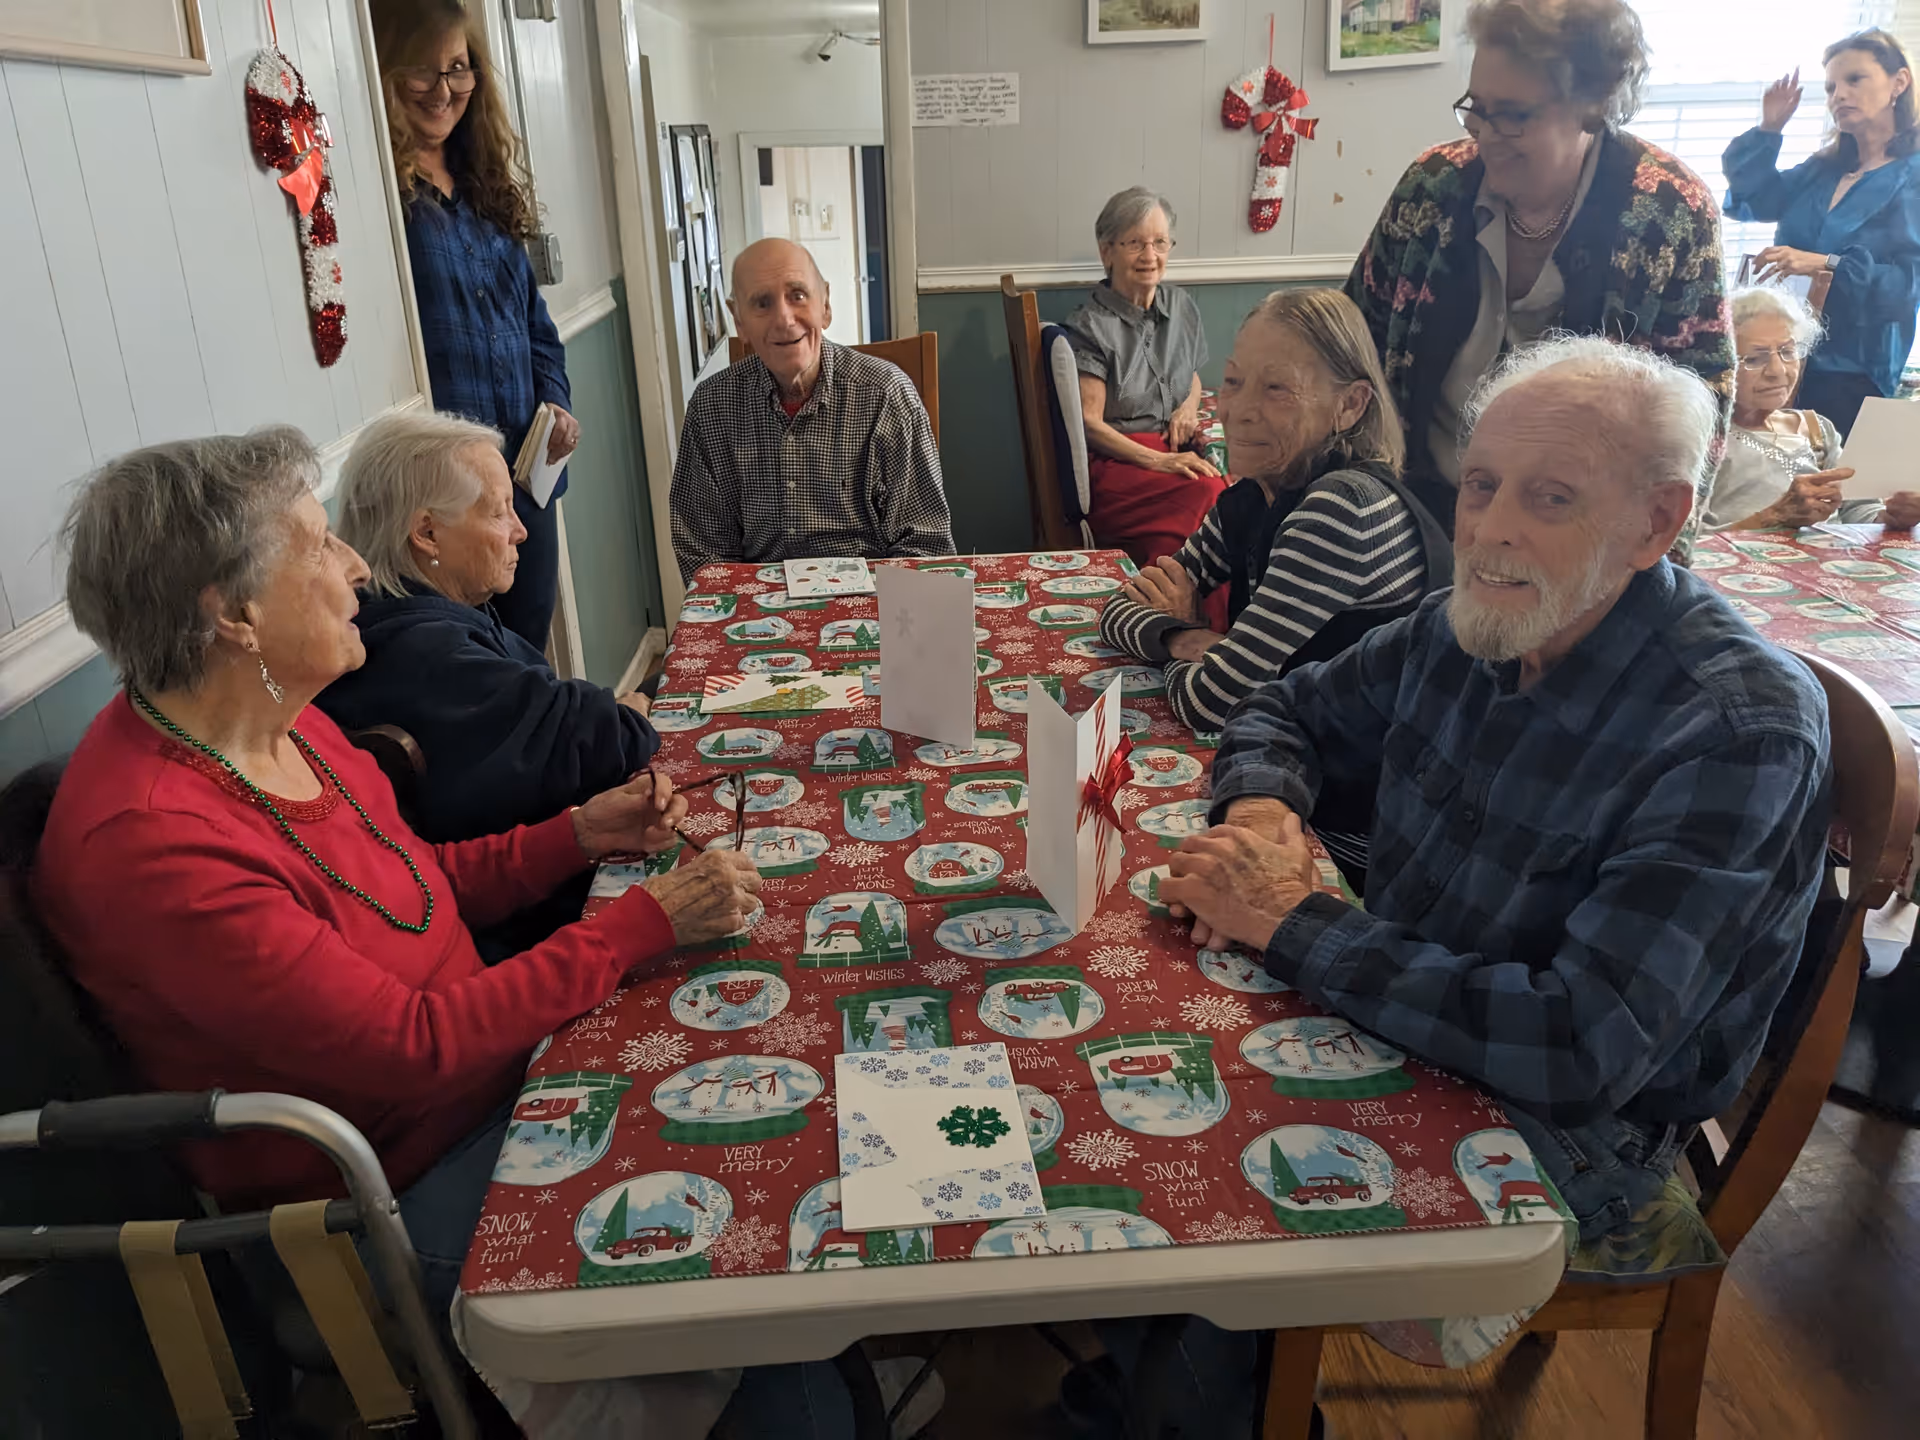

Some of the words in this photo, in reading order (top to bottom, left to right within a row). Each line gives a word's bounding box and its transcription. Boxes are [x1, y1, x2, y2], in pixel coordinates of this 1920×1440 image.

[826, 773, 860, 783] winter
[972, 825, 1003, 835] WARM
[855, 878, 895, 890] SNOW
[820, 969, 862, 984] winter
[865, 968, 906, 981] WISHES
[1116, 979, 1158, 993] MERRY
[1119, 992, 1164, 1004] Very
[570, 1015, 618, 1031] MERRY
[568, 1030, 612, 1041] Very
[1006, 1046, 1041, 1060] wish
[1017, 1055, 1060, 1070] WARM
[1345, 1100, 1388, 1116] VERY
[1352, 1112, 1422, 1128] merry
[724, 1145, 764, 1161] VERY
[717, 1157, 794, 1174] merry
[1142, 1159, 1198, 1181] SNOW
[1158, 1177, 1210, 1192] what
[1166, 1190, 1206, 1208] fun!
[475, 1211, 538, 1236] SNOW
[483, 1231, 537, 1247] what
[479, 1245, 523, 1265] fun!
